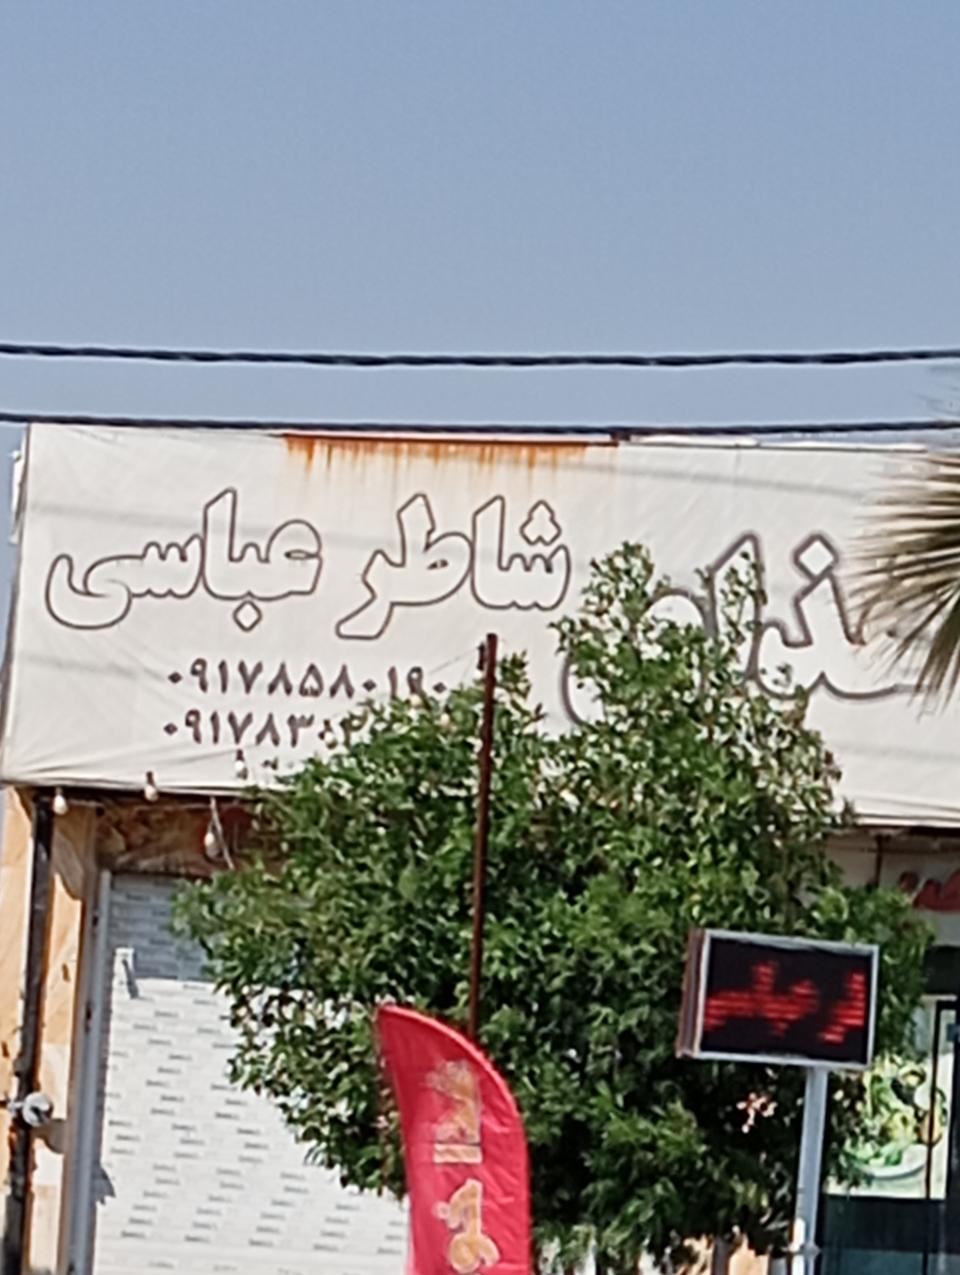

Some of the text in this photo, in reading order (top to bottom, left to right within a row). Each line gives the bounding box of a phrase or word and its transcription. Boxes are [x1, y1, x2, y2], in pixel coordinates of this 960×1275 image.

[45, 487, 323, 631] عباسی
[335, 494, 571, 640] شاطر
[167, 657, 447, 699] ۰۹۱۷۸۵۸۰۱۹۰
